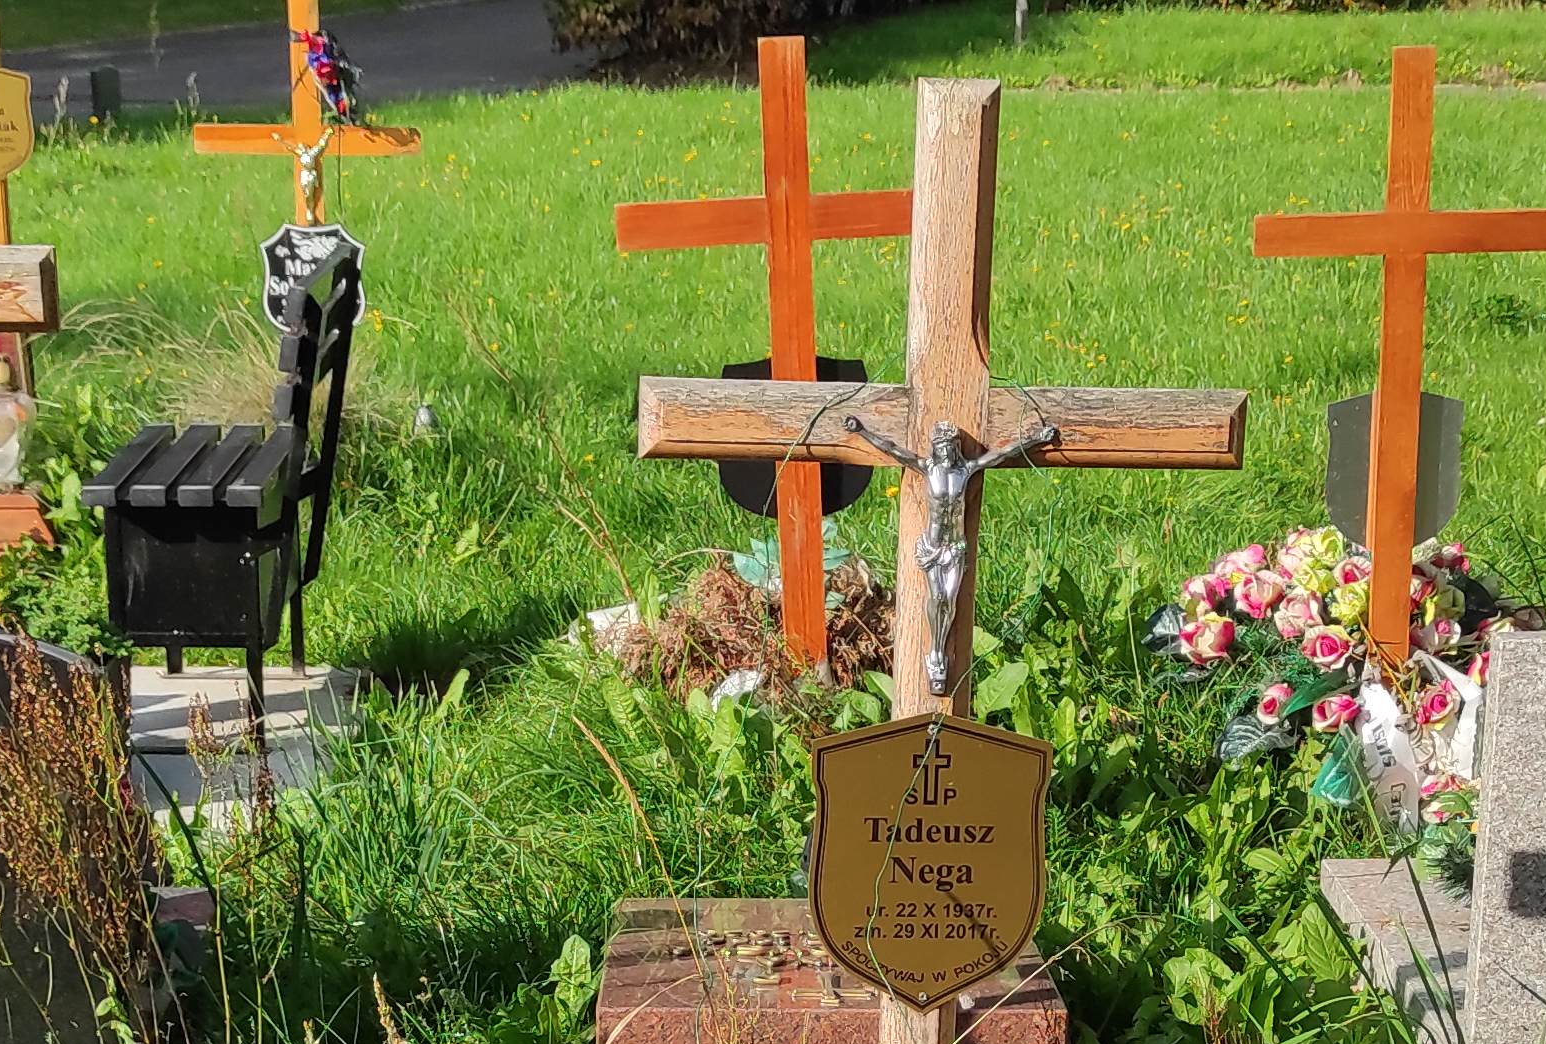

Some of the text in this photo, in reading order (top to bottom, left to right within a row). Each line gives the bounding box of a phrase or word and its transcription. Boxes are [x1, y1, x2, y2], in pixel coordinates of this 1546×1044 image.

[943, 788, 957, 805] P
[864, 817, 995, 844] Tadeusz
[888, 856, 973, 892] Nega
[866, 902, 998, 918] ur. 22 X 1937r.
[854, 923, 1000, 939] zm. 29 XI 2017r.
[841, 940, 925, 983] SPOCZYWAJ
[932, 971, 946, 982] W
[954, 940, 1008, 978] POKOJU
